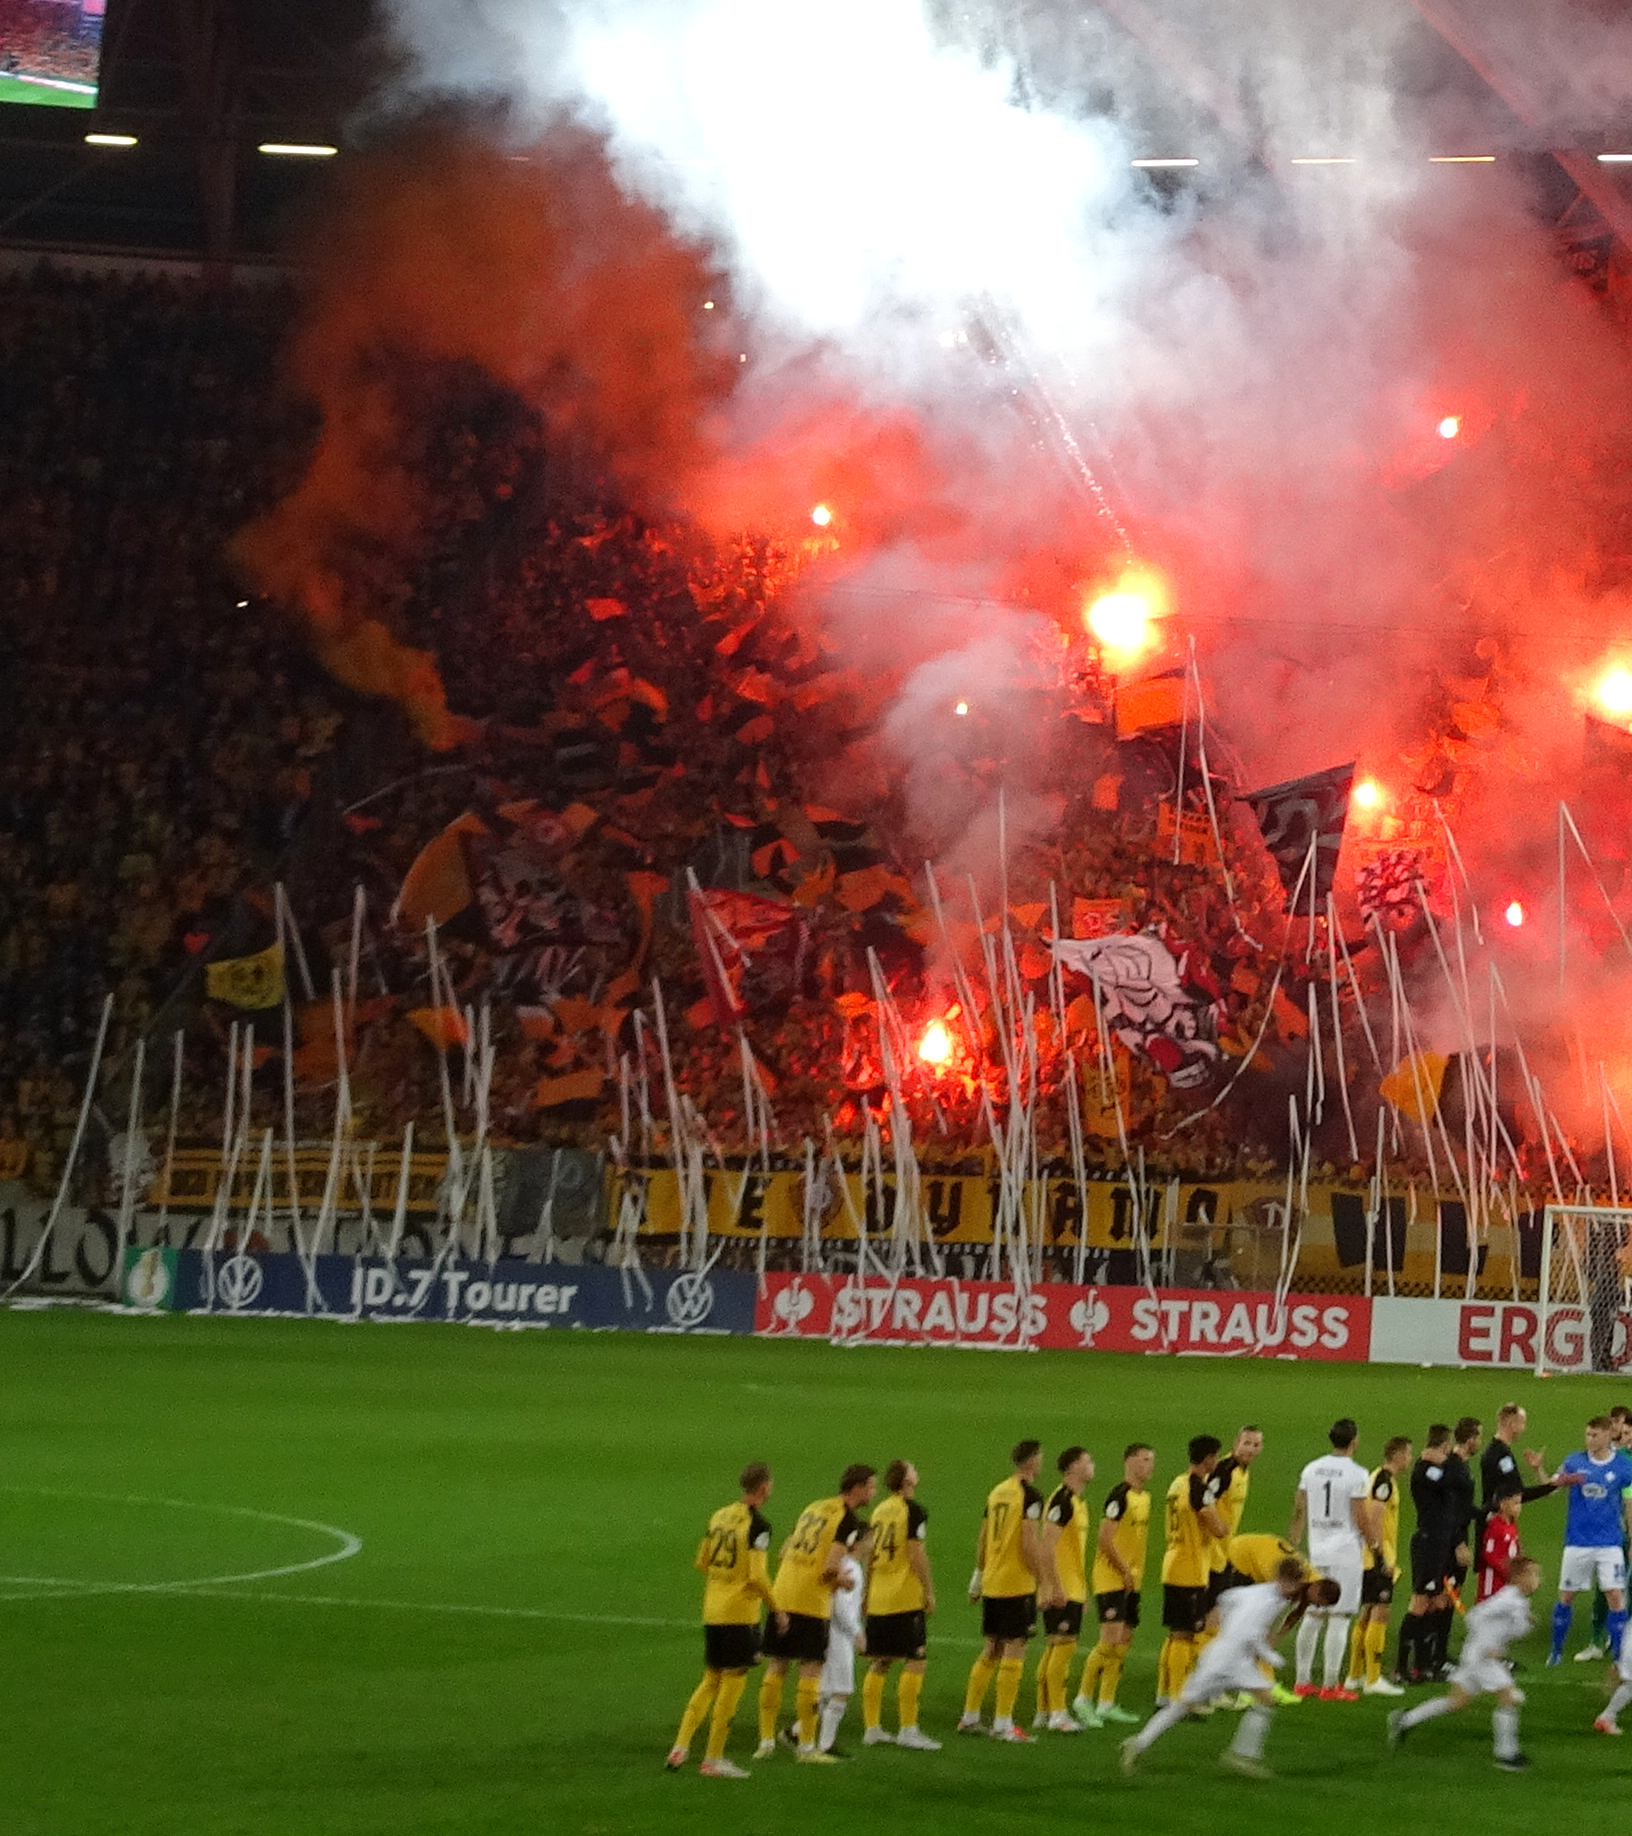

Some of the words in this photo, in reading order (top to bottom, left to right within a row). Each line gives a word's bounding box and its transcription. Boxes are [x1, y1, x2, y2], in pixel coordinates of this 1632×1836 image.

[442, 1270, 579, 1314] Tourer
[836, 1284, 1048, 1338] STRAUSS
[1130, 1298, 1350, 1349] STRAUSS
[1323, 1479, 1332, 1518] 1
